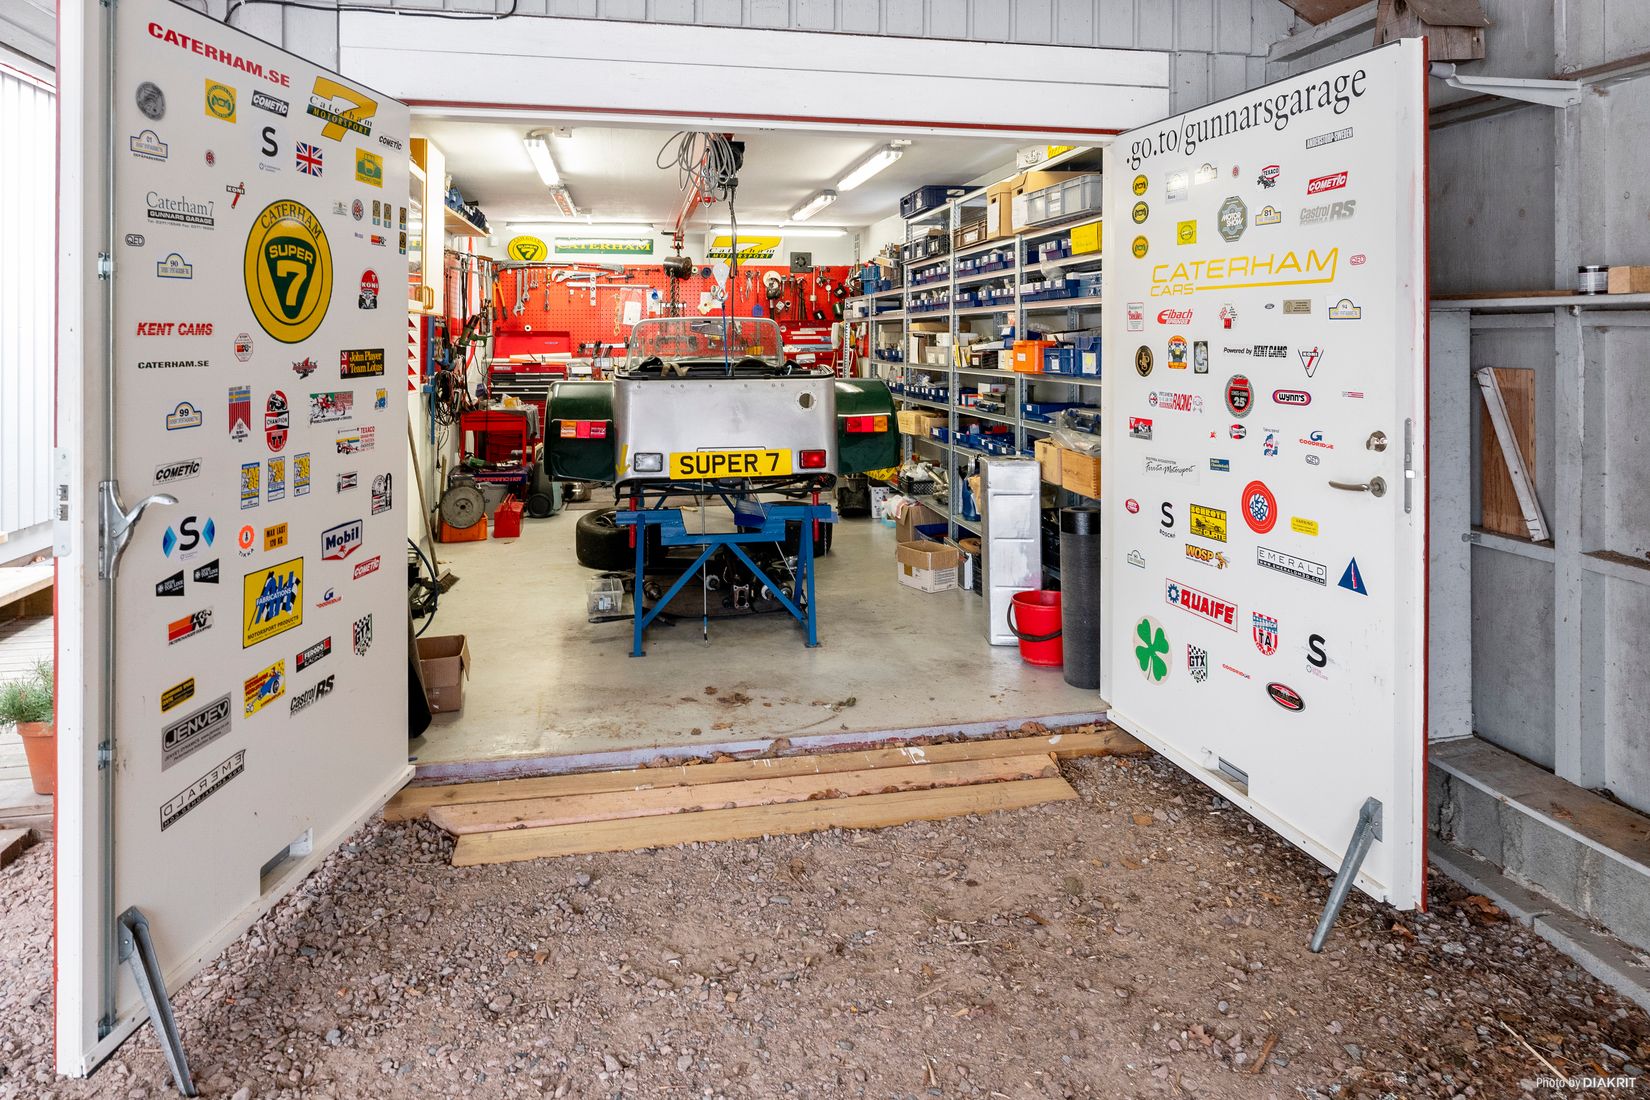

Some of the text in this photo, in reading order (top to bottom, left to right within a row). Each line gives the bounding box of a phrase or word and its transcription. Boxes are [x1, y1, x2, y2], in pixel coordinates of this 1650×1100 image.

[147, 22, 291, 88] CATERHAM.SE
[253, 94, 289, 114] COMETIC
[309, 95, 374, 128] Caterham
[312, 107, 370, 135] MOTORSPORT
[261, 126, 279, 158] S
[379, 135, 403, 151] COMETIC
[1263, 167, 1280, 177] TEXACO
[227, 186, 245, 195] KONI
[1309, 175, 1347, 192] COMETIC
[149, 210, 185, 221] GUNNARS
[185, 215, 213, 225] GARAGE
[1221, 211, 1242, 222] MOTOR
[1263, 209, 1273, 217] 81
[1300, 199, 1357, 222] Castrol RS
[260, 203, 322, 241] CATERHAM
[1226, 217, 1244, 227] SHOW
[269, 244, 314, 264] SUPER
[1152, 247, 1339, 284] CATERHAM
[276, 259, 308, 307] 7
[361, 281, 379, 289] KONI
[1150, 283, 1194, 297] CARS
[136, 322, 214, 336] KENT CAMS
[350, 349, 382, 363] John Player
[1223, 345, 1288, 358] Powered by KENT CAMS
[137, 360, 210, 370] CATERHAM.SE
[350, 361, 384, 374] Team Lotus
[179, 408, 190, 417] 99
[266, 417, 288, 426] CHAMPION
[155, 461, 200, 481] COMETIC
[680, 452, 780, 475] SUPER 7
[1160, 501, 1175, 529] S
[1191, 505, 1226, 521] SCHROTH
[179, 516, 200, 551] S
[276, 525, 286, 535] LAST
[325, 526, 360, 551] Mobil
[277, 535, 284, 545] KG
[1185, 543, 1214, 563] WOSP
[354, 560, 380, 577] COMETIC
[1259, 549, 1325, 577] EMERALD
[256, 587, 292, 606] FABRICATIONS
[1180, 588, 1235, 625] QUAIFE
[247, 615, 299, 640] MOTORSPORT PRODUCTS
[355, 621, 371, 645] GTX
[1306, 633, 1327, 668] S
[1189, 655, 1206, 668] GTX
[290, 684, 317, 711] Castrol
[315, 674, 335, 701] RS
[166, 702, 228, 748] JENVEY
